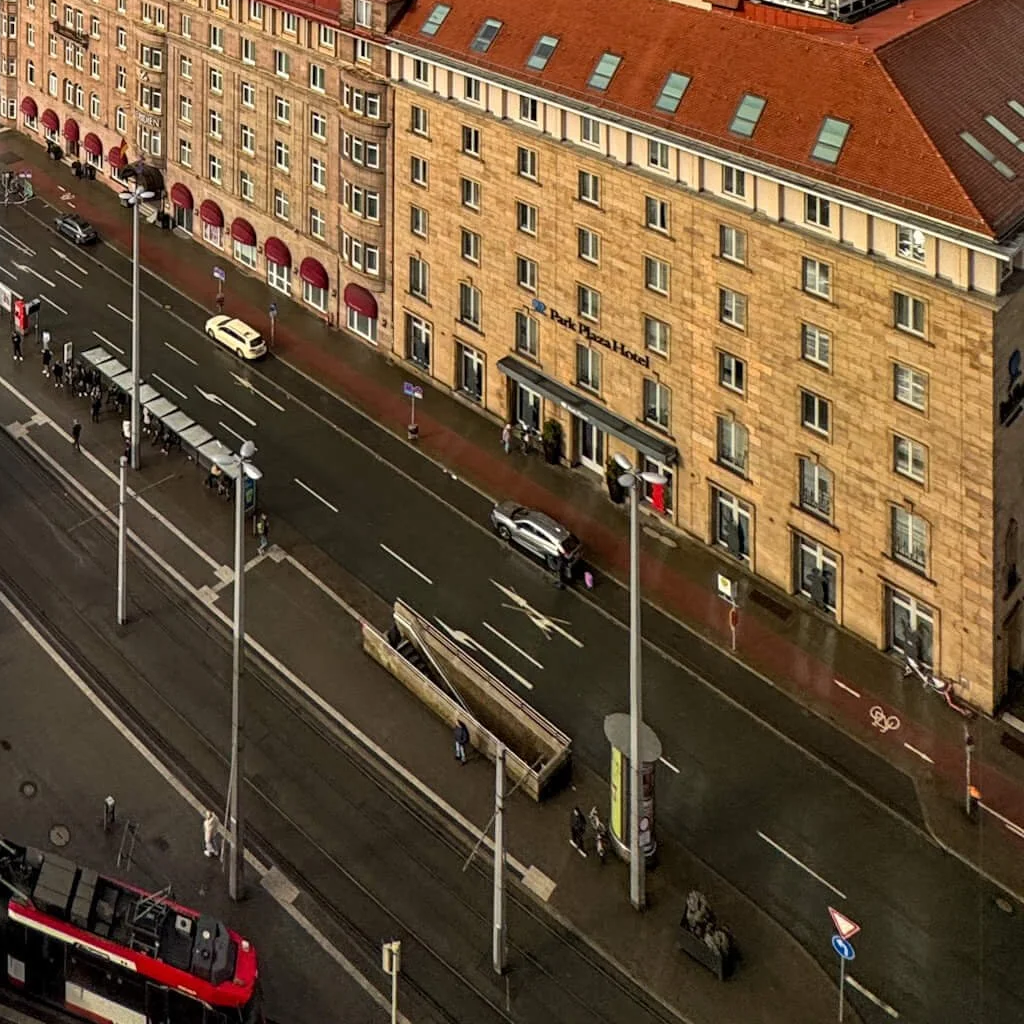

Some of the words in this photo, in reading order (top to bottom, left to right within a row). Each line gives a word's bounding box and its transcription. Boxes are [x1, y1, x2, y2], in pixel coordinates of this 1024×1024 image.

[550, 307, 577, 332] Park
[578, 321, 612, 349] Plaza
[612, 338, 651, 369] Hotel
